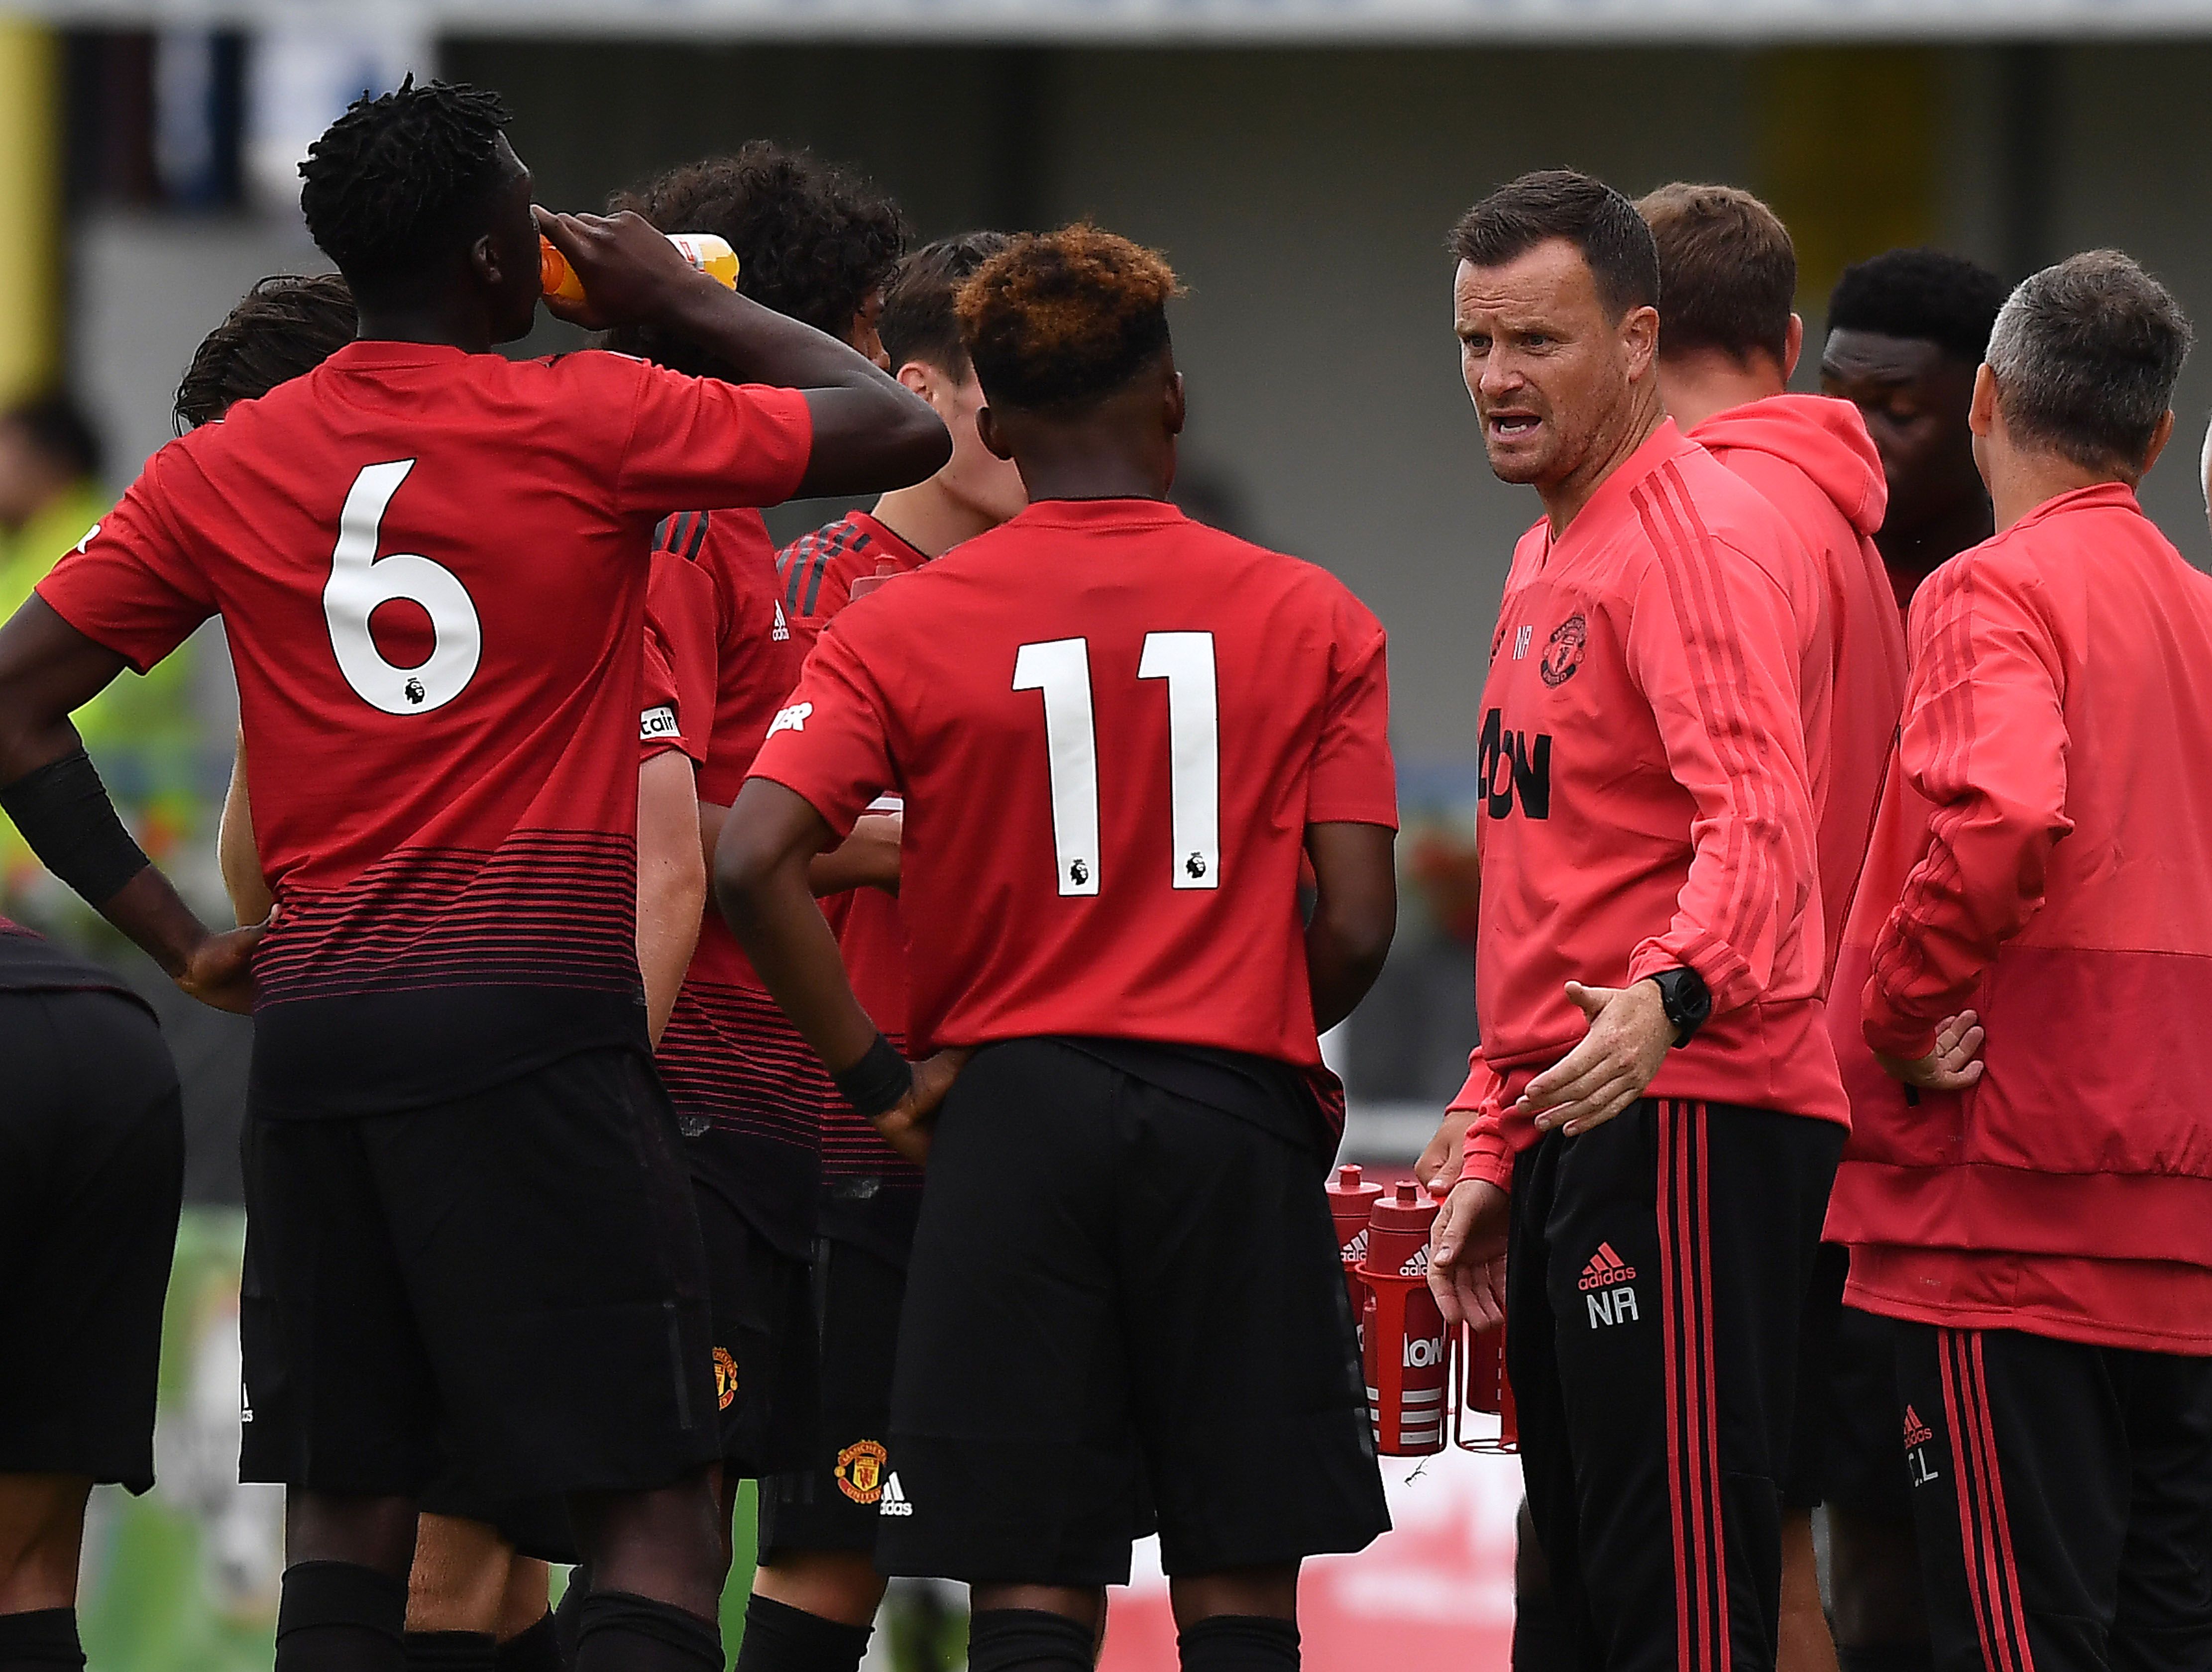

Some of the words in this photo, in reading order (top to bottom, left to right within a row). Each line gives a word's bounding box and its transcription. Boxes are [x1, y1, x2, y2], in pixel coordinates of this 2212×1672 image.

[323, 458, 482, 716] 6
[1012, 630, 1221, 897] 11
[1578, 1267, 1636, 1290] adidas
